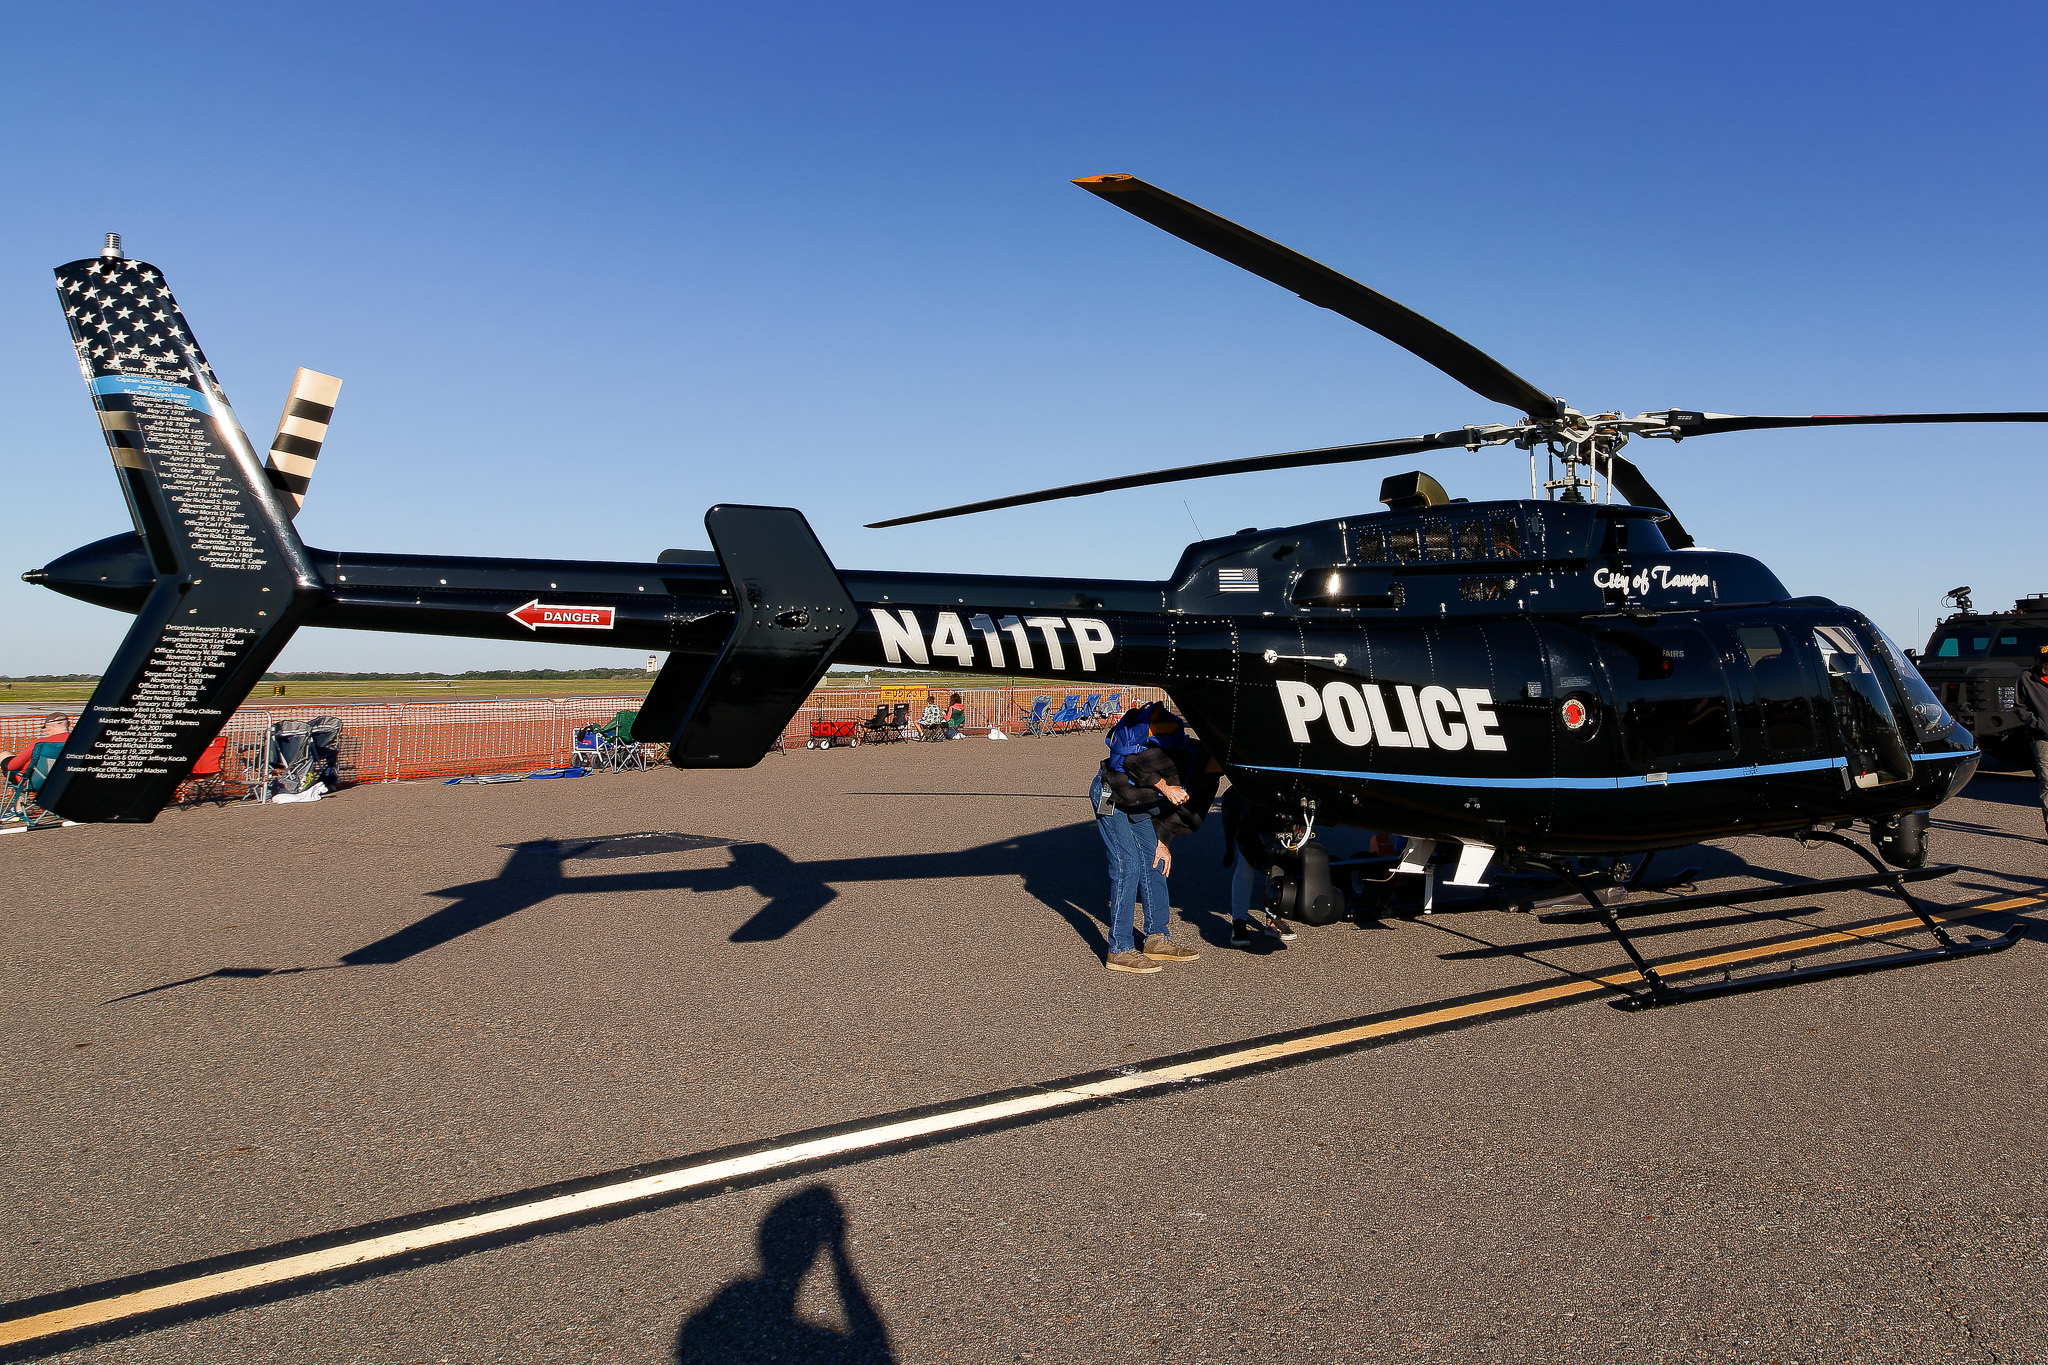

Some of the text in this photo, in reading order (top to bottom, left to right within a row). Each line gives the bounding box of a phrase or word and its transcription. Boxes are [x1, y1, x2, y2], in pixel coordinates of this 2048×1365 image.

[1593, 565, 1709, 595] City of Tampa
[544, 611, 599, 622] DANGER
[870, 608, 1114, 671] N411TP
[1276, 680, 1508, 751] POLICE
